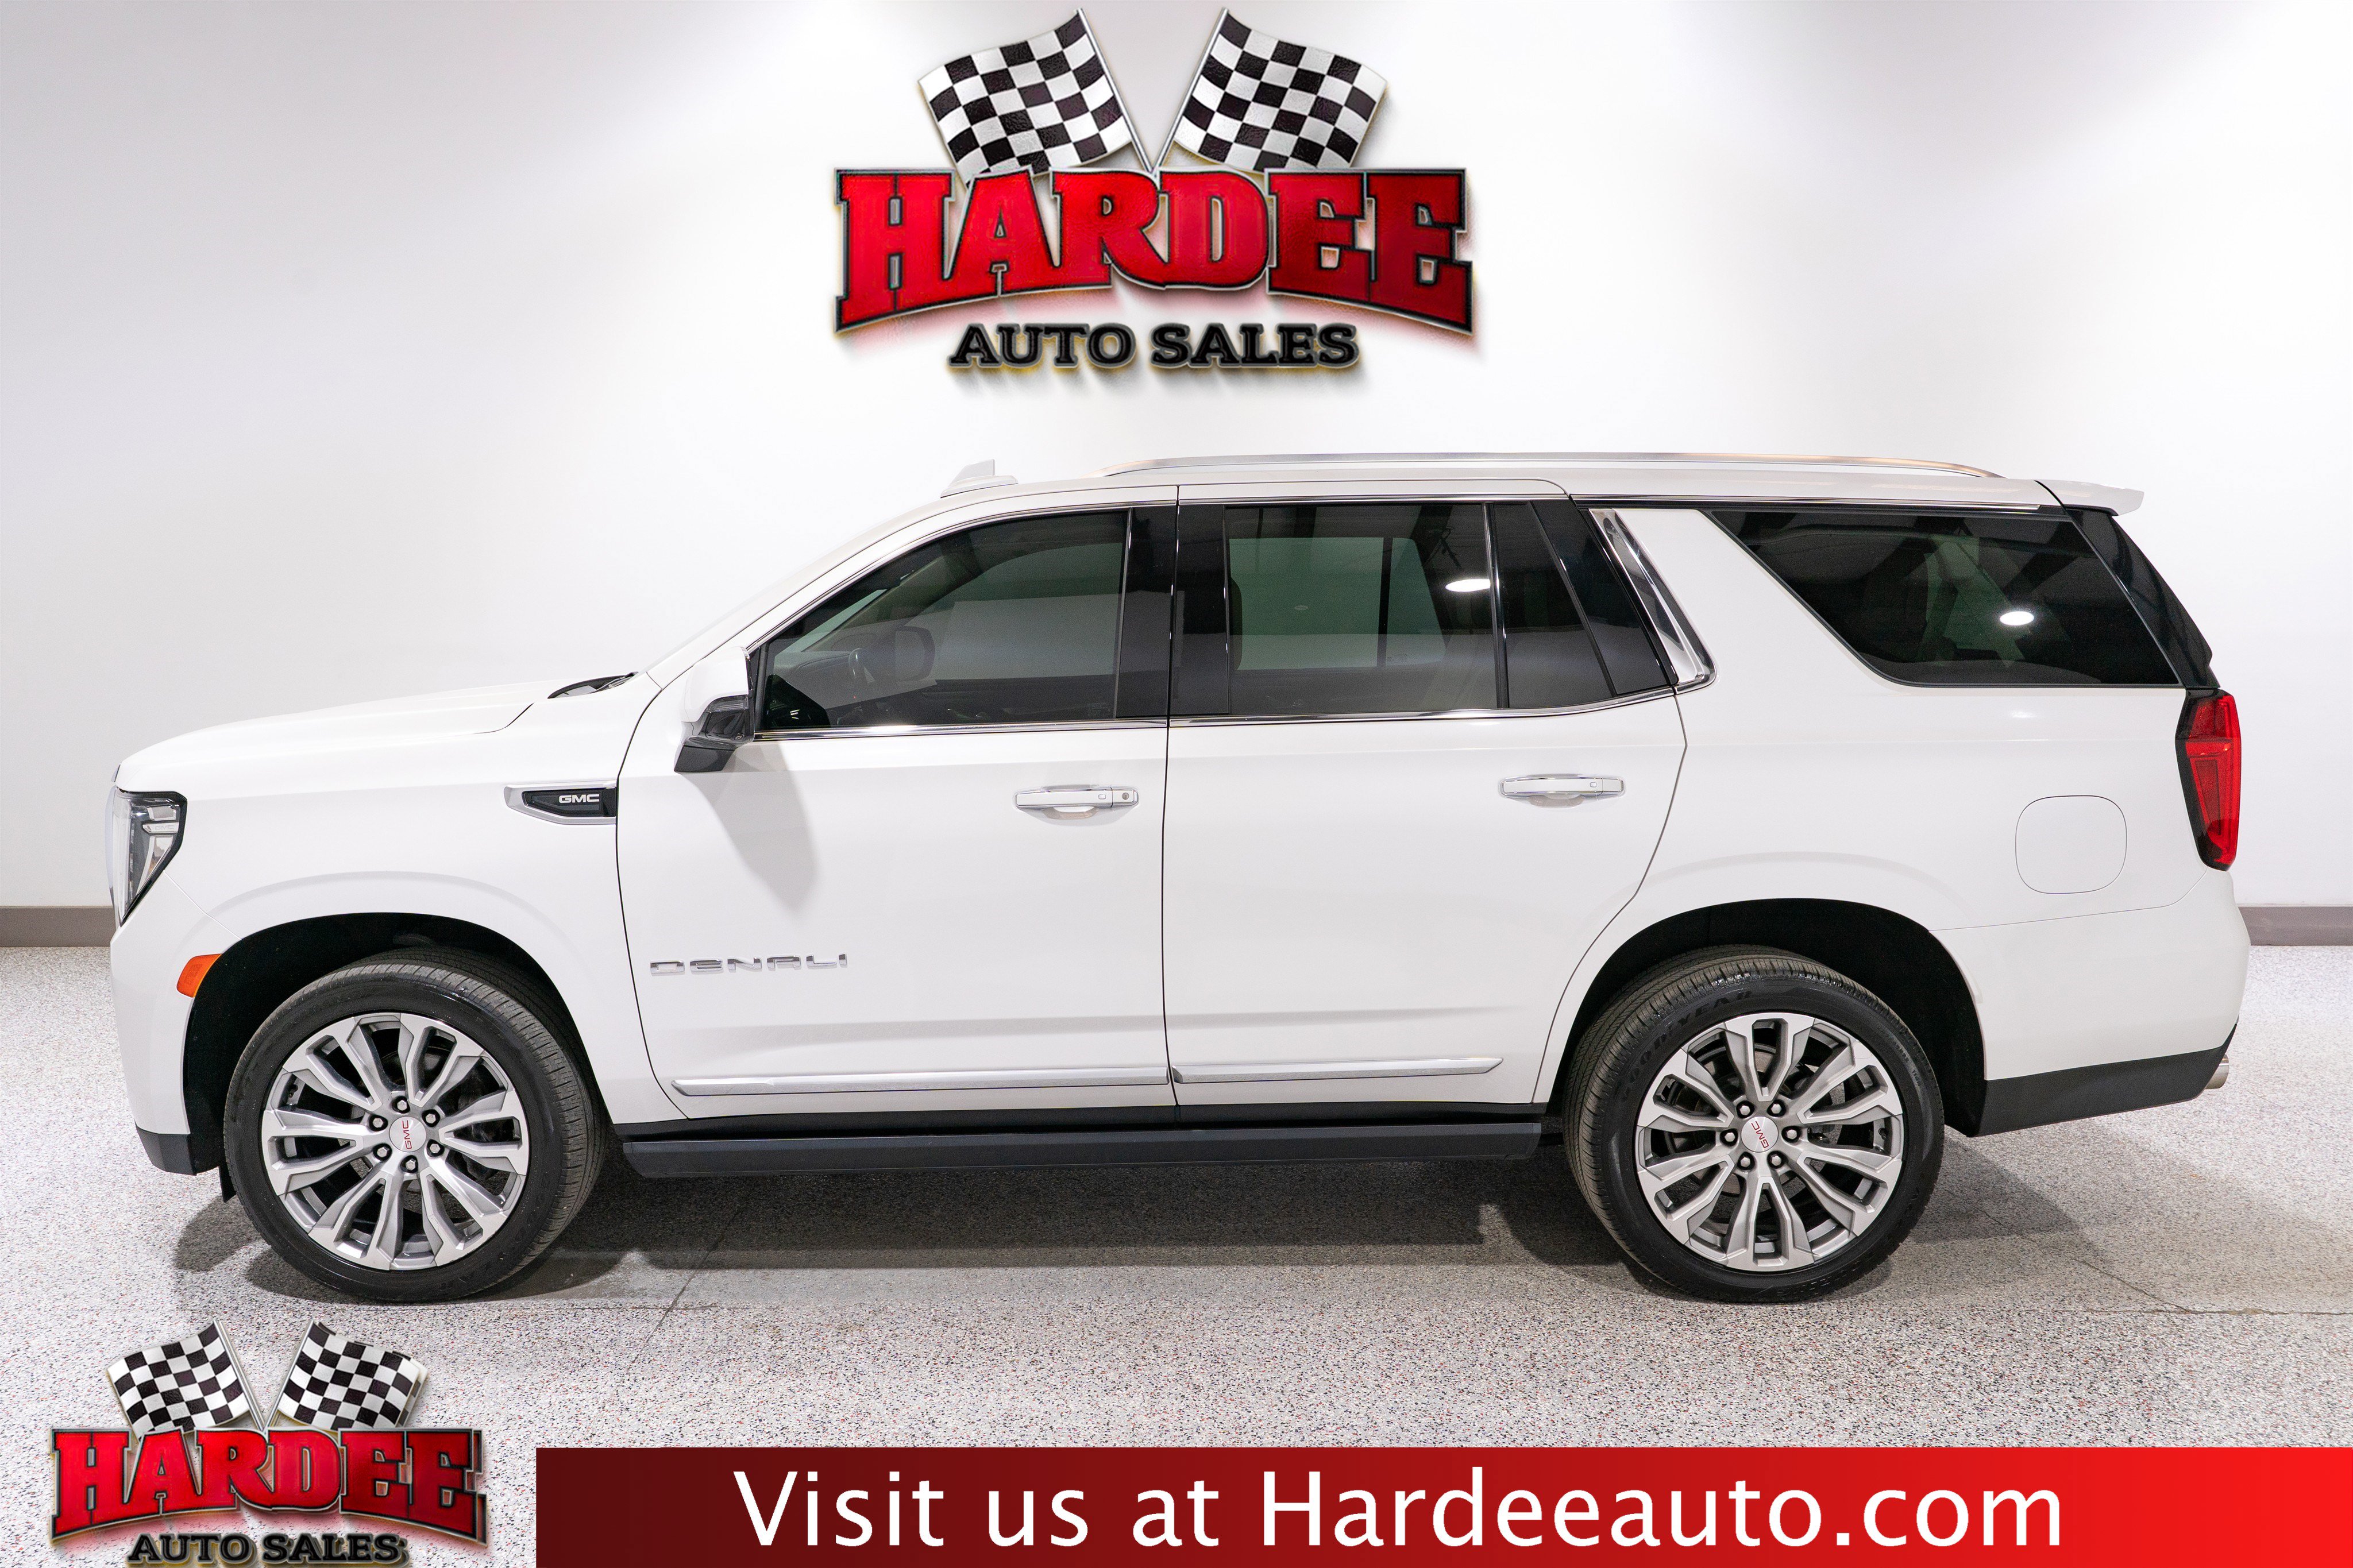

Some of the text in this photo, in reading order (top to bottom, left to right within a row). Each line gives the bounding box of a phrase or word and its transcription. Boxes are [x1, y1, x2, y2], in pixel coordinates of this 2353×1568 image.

[835, 167, 1474, 335] HARDEE
[948, 323, 1360, 368] AUTO SALES
[559, 794, 599, 804] GMC
[650, 952, 848, 975] DENALI
[402, 1120, 412, 1149] GMC
[1751, 1121, 1769, 1148] GMC
